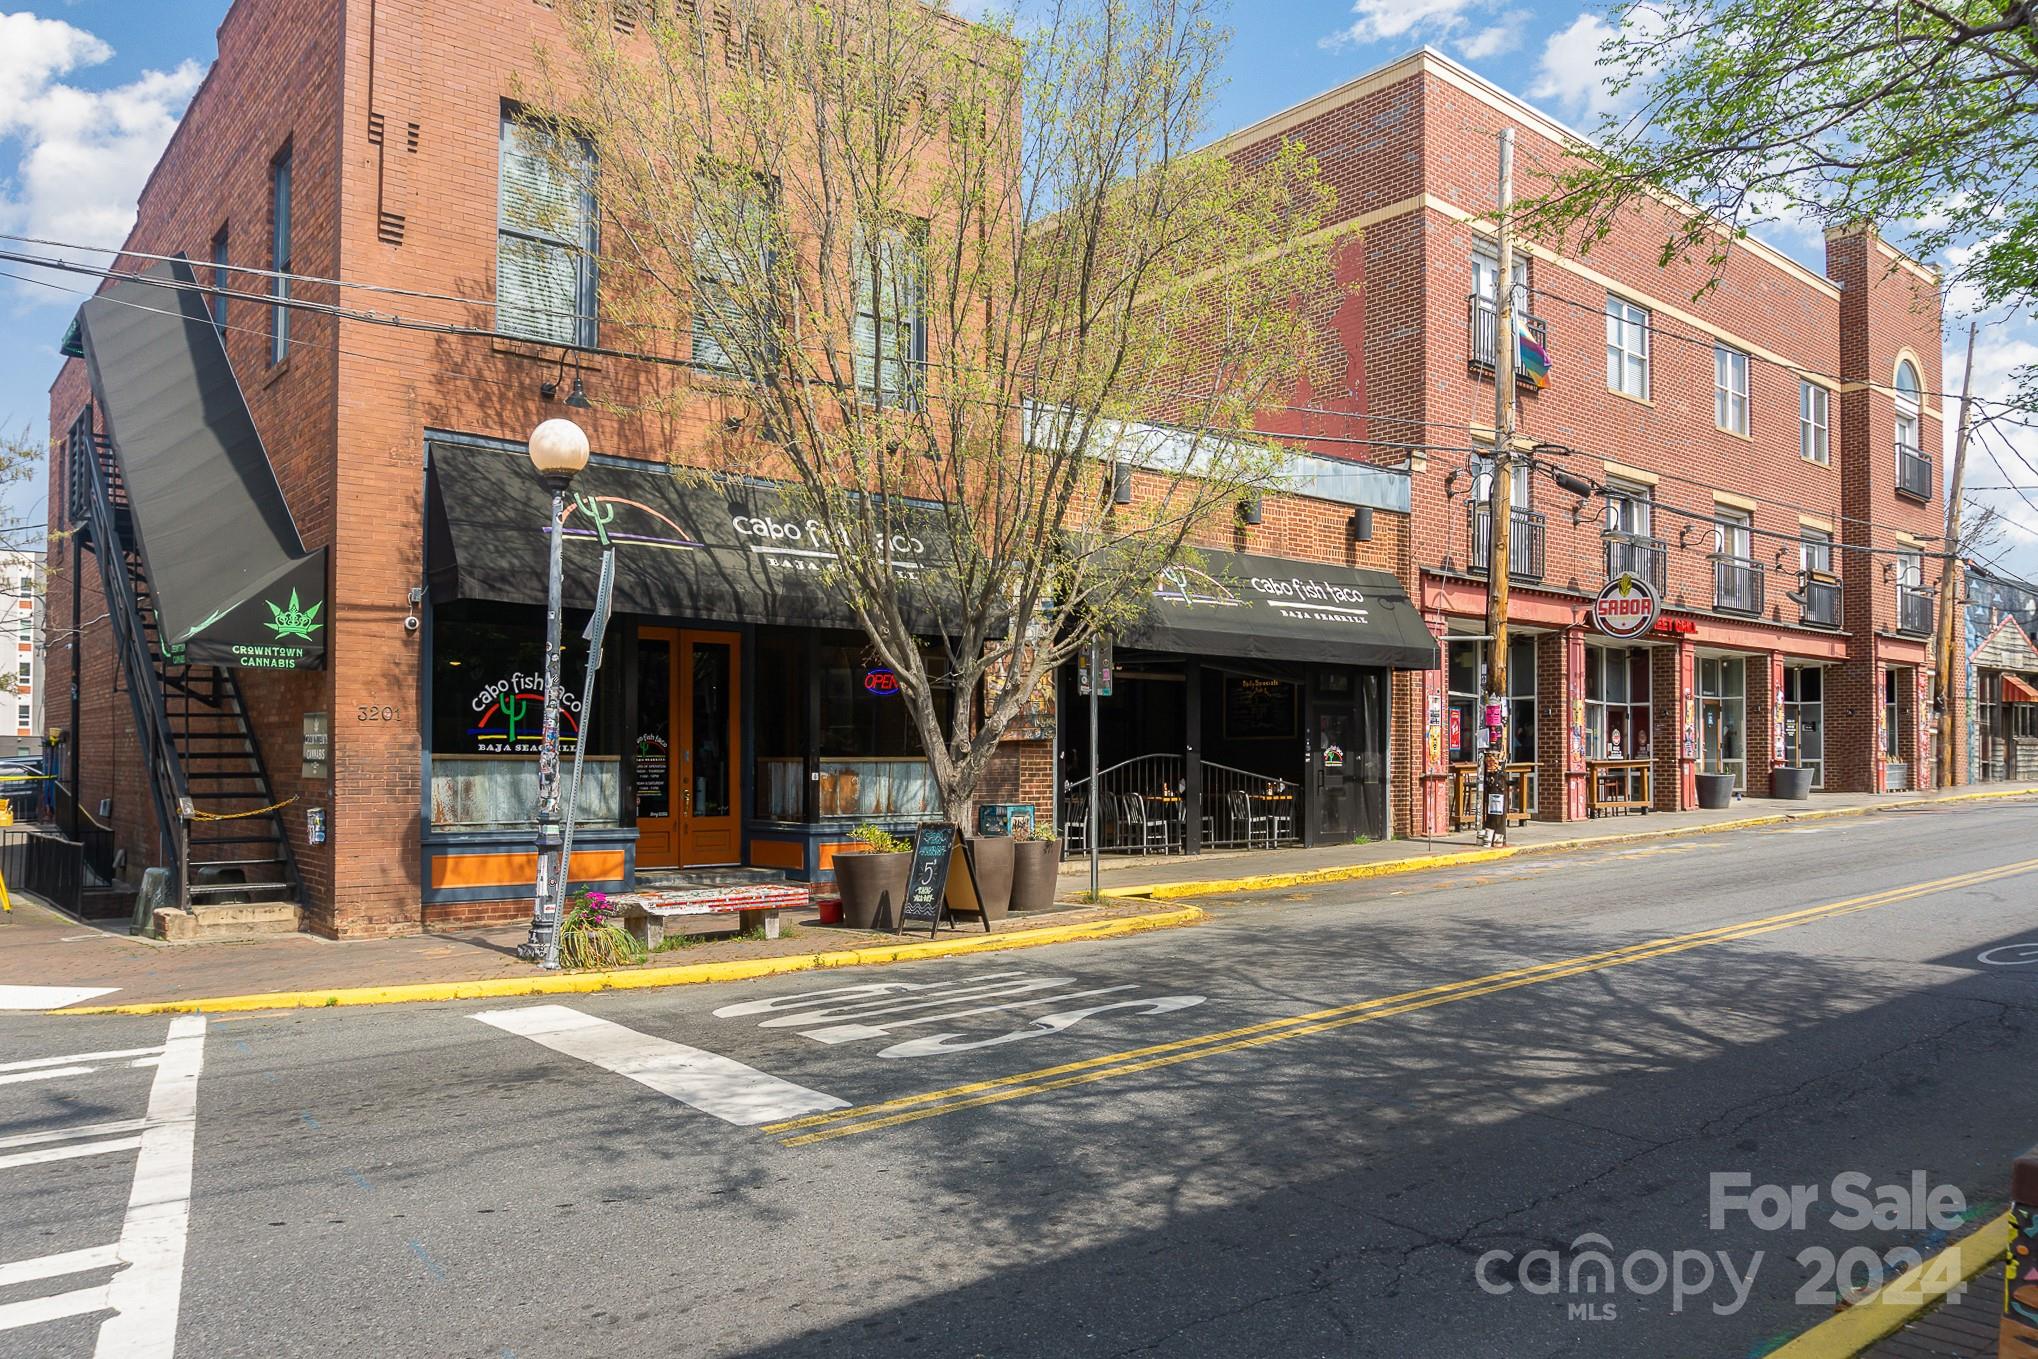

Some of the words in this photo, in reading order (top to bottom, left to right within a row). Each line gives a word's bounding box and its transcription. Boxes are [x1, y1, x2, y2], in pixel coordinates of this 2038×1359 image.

[732, 515, 801, 540] cabo
[768, 558, 819, 570] BAJA
[1251, 577, 1294, 596] cabo
[1292, 578, 1328, 601] fish
[1324, 581, 1364, 603] taco
[1280, 609, 1312, 619] BAJA
[1314, 612, 1369, 624] SEAGRILL
[231, 645, 303, 657] CROWNTOWN
[240, 657, 296, 669] CANNABIS
[864, 673, 899, 689] OPEN
[472, 680, 509, 712] cabo
[512, 672, 544, 694] fish
[357, 706, 402, 722] 3201
[478, 744, 512, 752] BAJA
